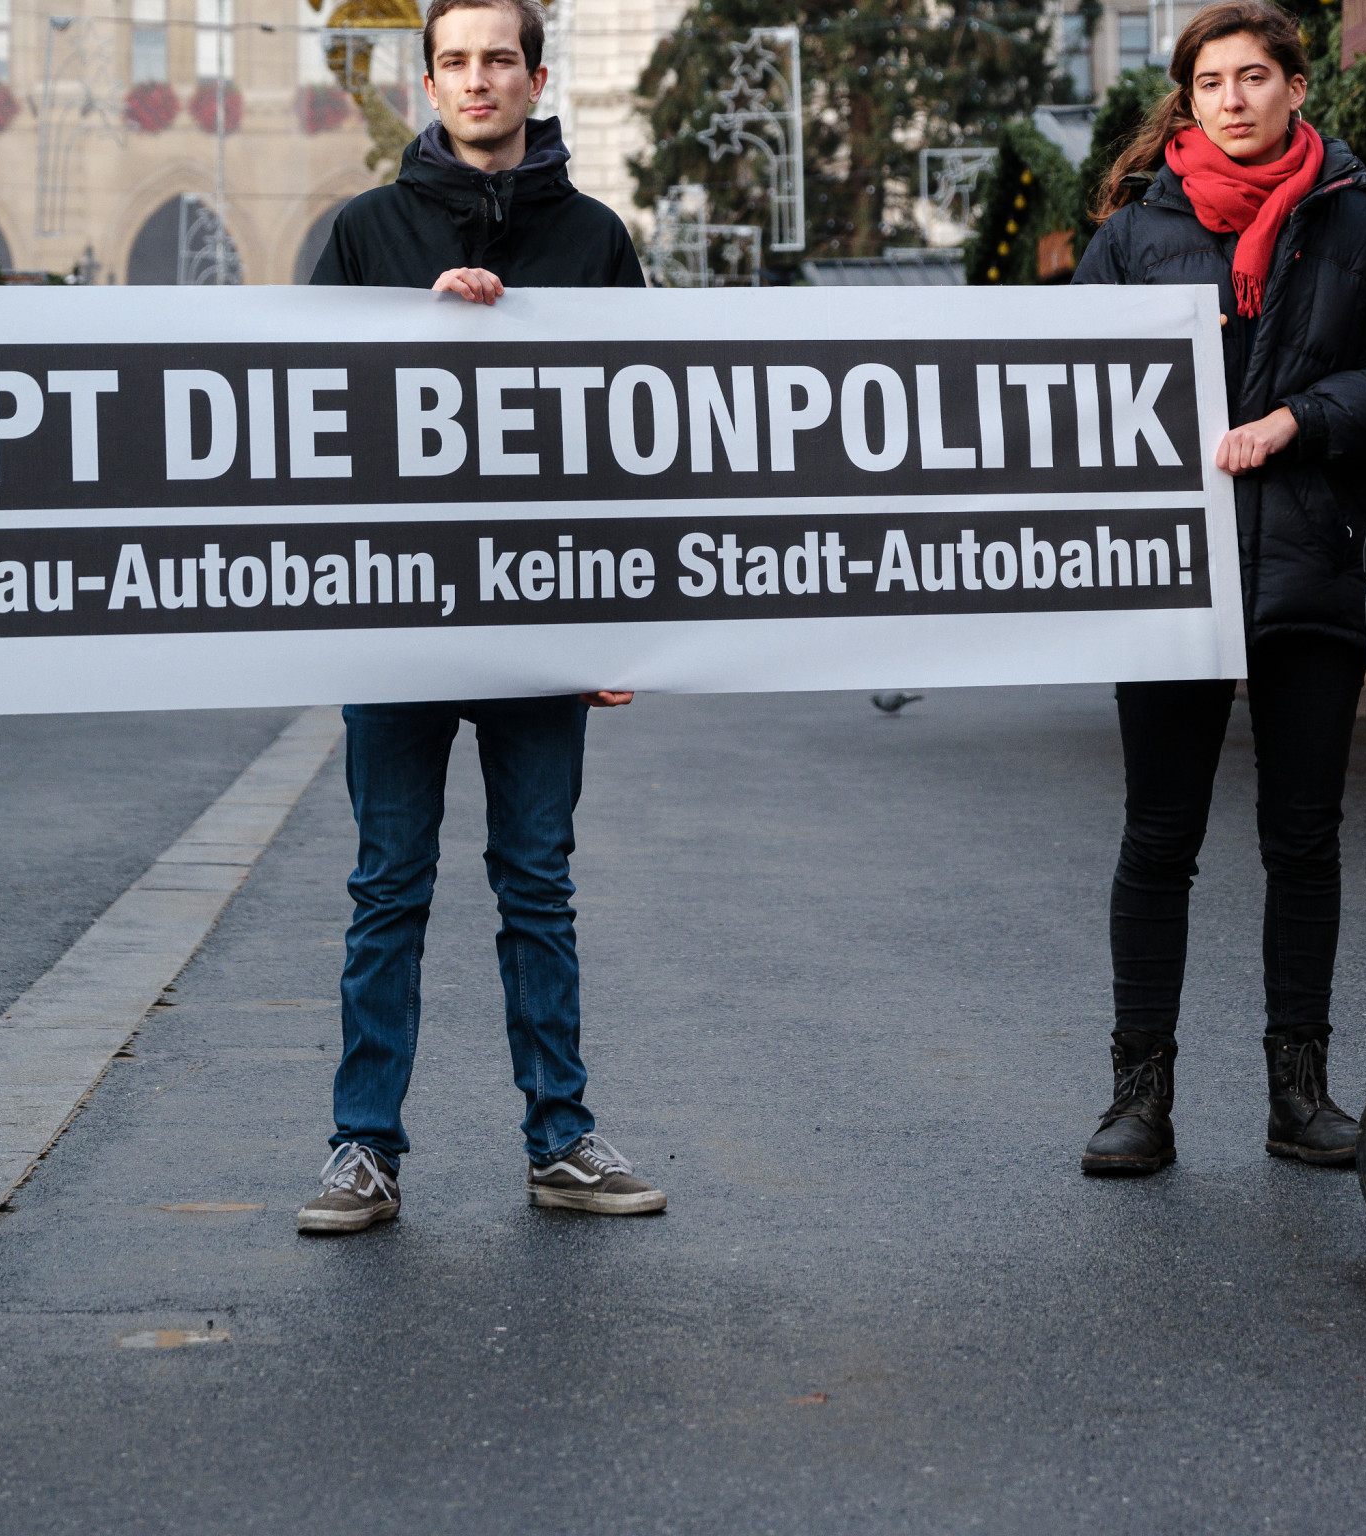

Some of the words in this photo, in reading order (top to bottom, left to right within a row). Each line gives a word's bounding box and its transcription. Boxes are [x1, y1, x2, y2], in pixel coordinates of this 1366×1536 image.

[163, 368, 353, 481] DIE
[395, 363, 1184, 477] BETONPOLITIK
[478, 535, 656, 602] keine
[678, 524, 1194, 598] Stadt-Autobahn!
